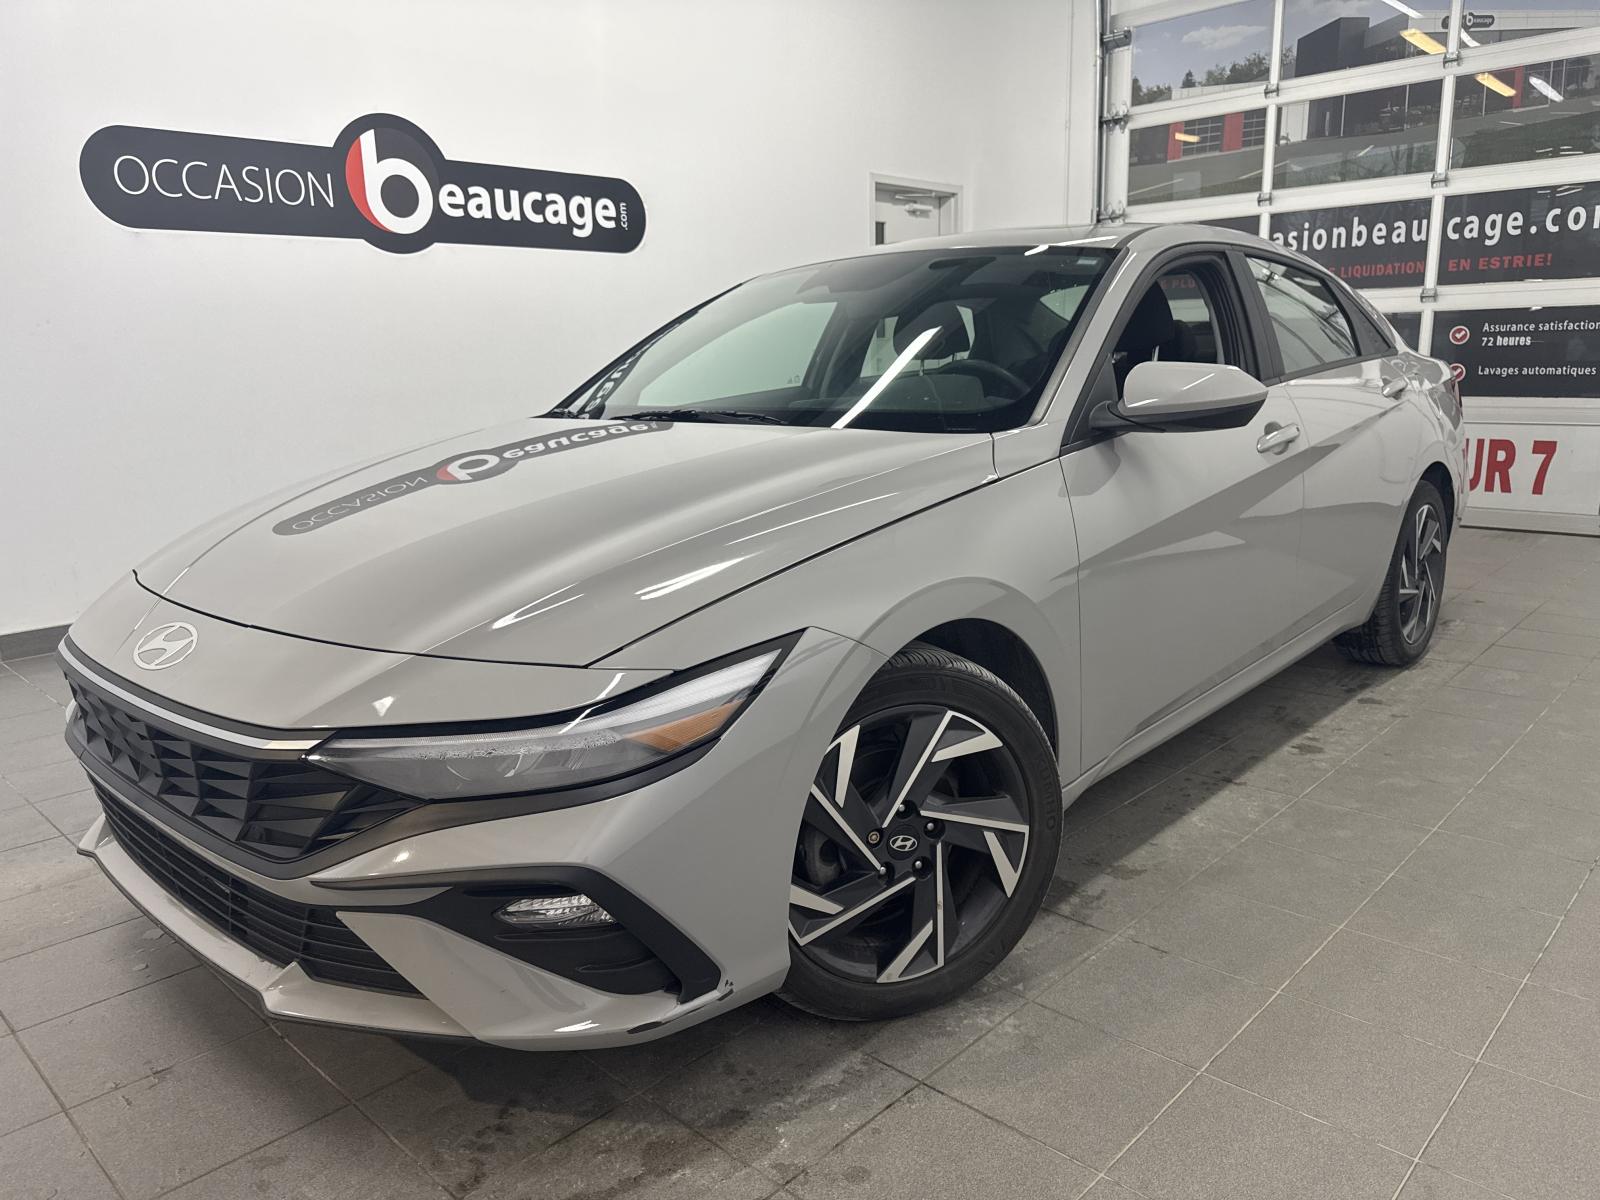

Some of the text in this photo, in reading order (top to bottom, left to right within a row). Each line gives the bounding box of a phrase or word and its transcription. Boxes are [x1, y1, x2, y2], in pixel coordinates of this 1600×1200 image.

[113, 155, 335, 208] OCCASION
[359, 128, 617, 238] beaucage
[1340, 261, 1425, 278] LIQUIDATION
[1448, 258, 1471, 272] EN
[1478, 253, 1553, 270] ESTRIE!
[1482, 322, 1536, 333] Assurance
[1481, 335, 1532, 347] 72 heures
[1478, 365, 1597, 378] Lavages automatiques
[1531, 439, 1558, 496] 7
